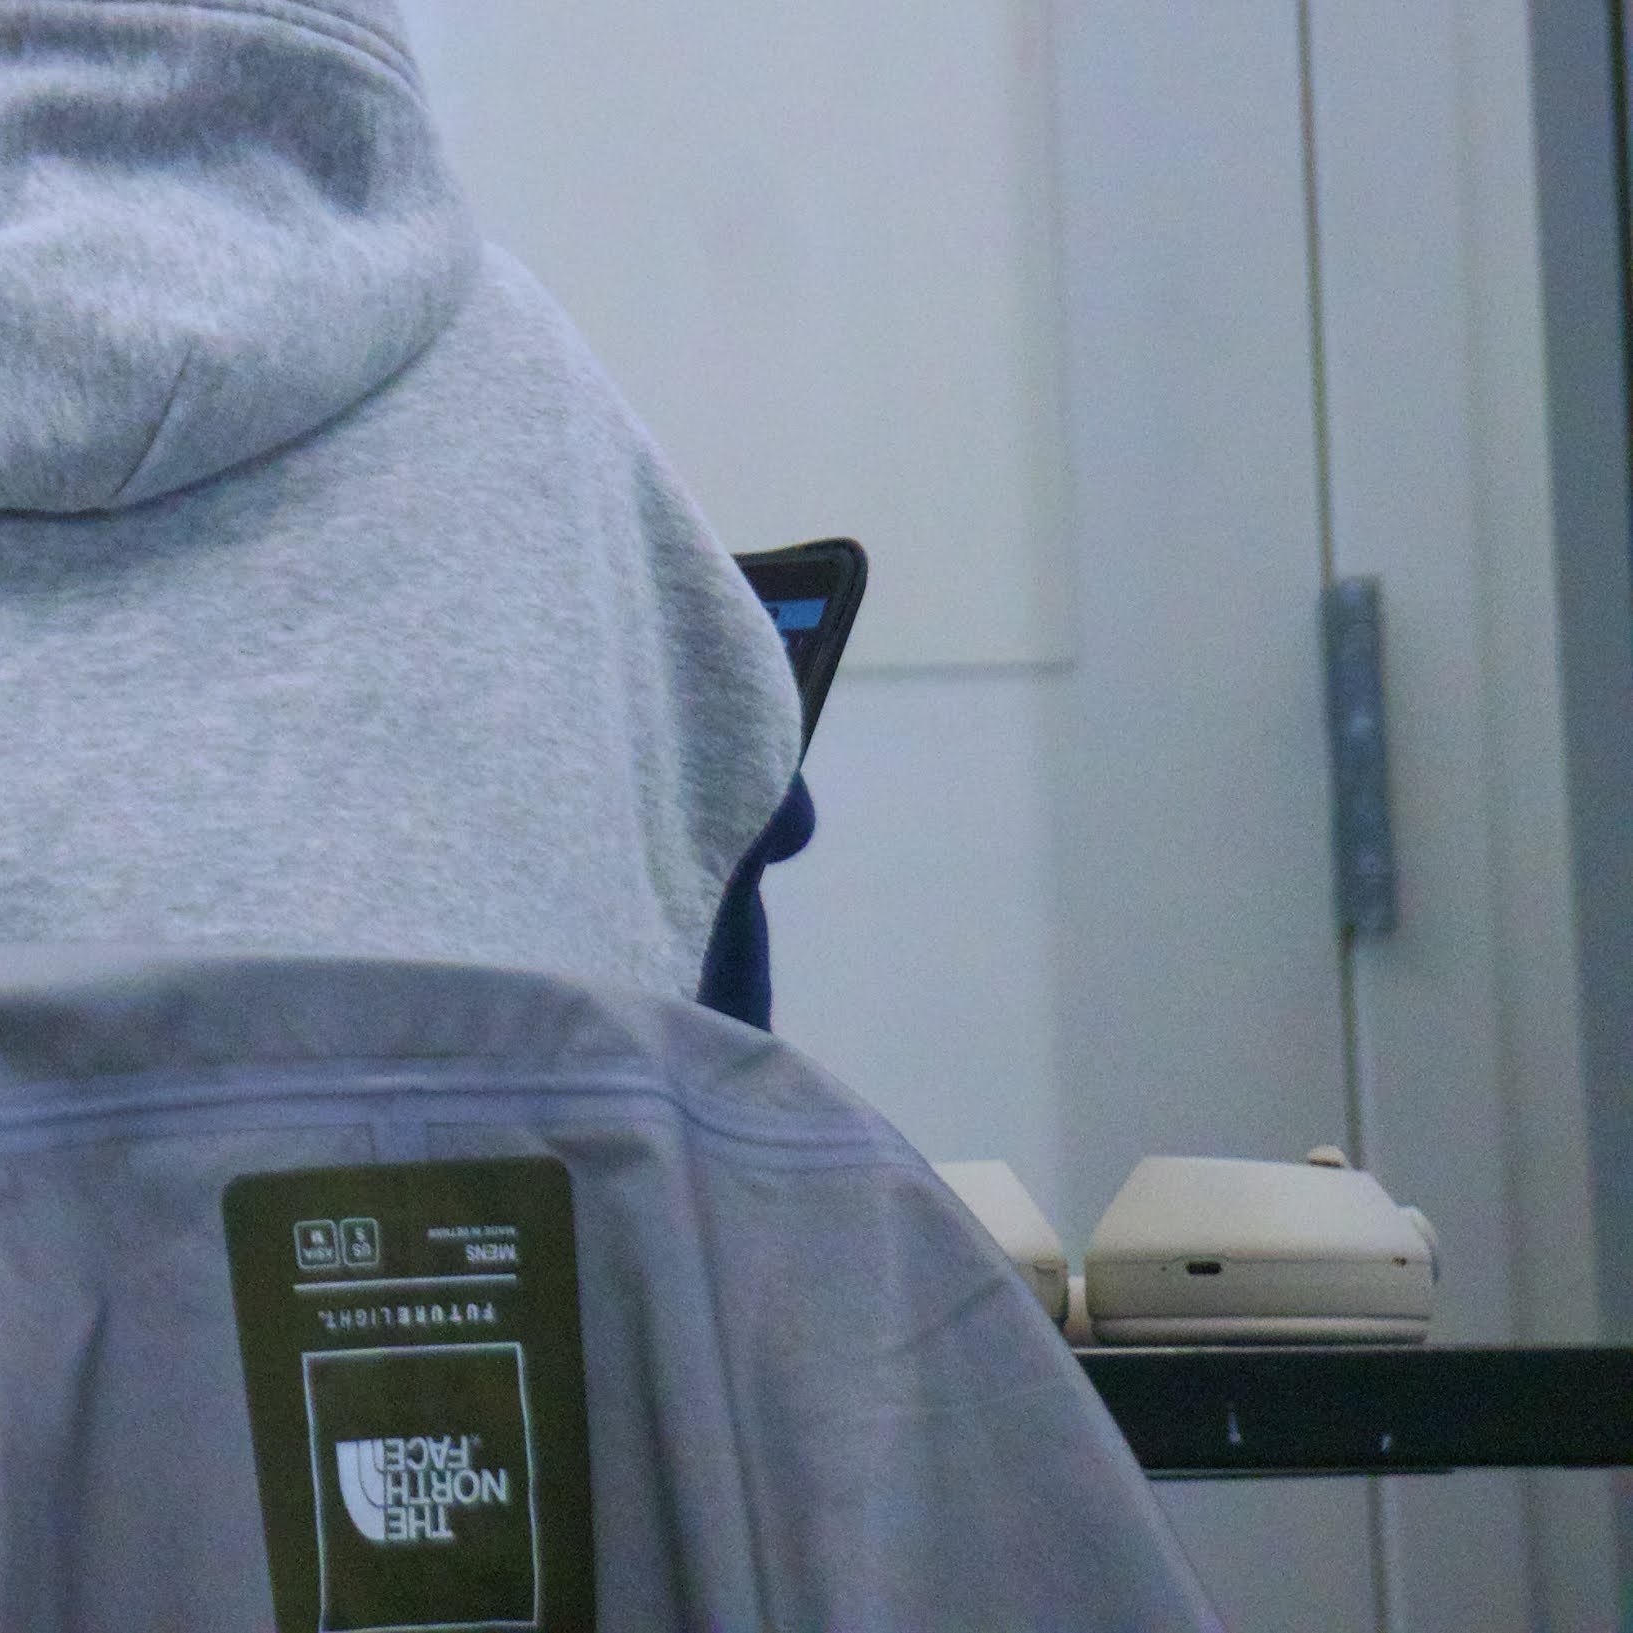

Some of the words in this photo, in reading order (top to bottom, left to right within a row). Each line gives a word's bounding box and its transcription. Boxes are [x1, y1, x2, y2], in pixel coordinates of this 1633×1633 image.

[385, 1435, 469, 1470] FACE
[385, 1468, 510, 1505] NORTH
[387, 1504, 454, 1541] THE
